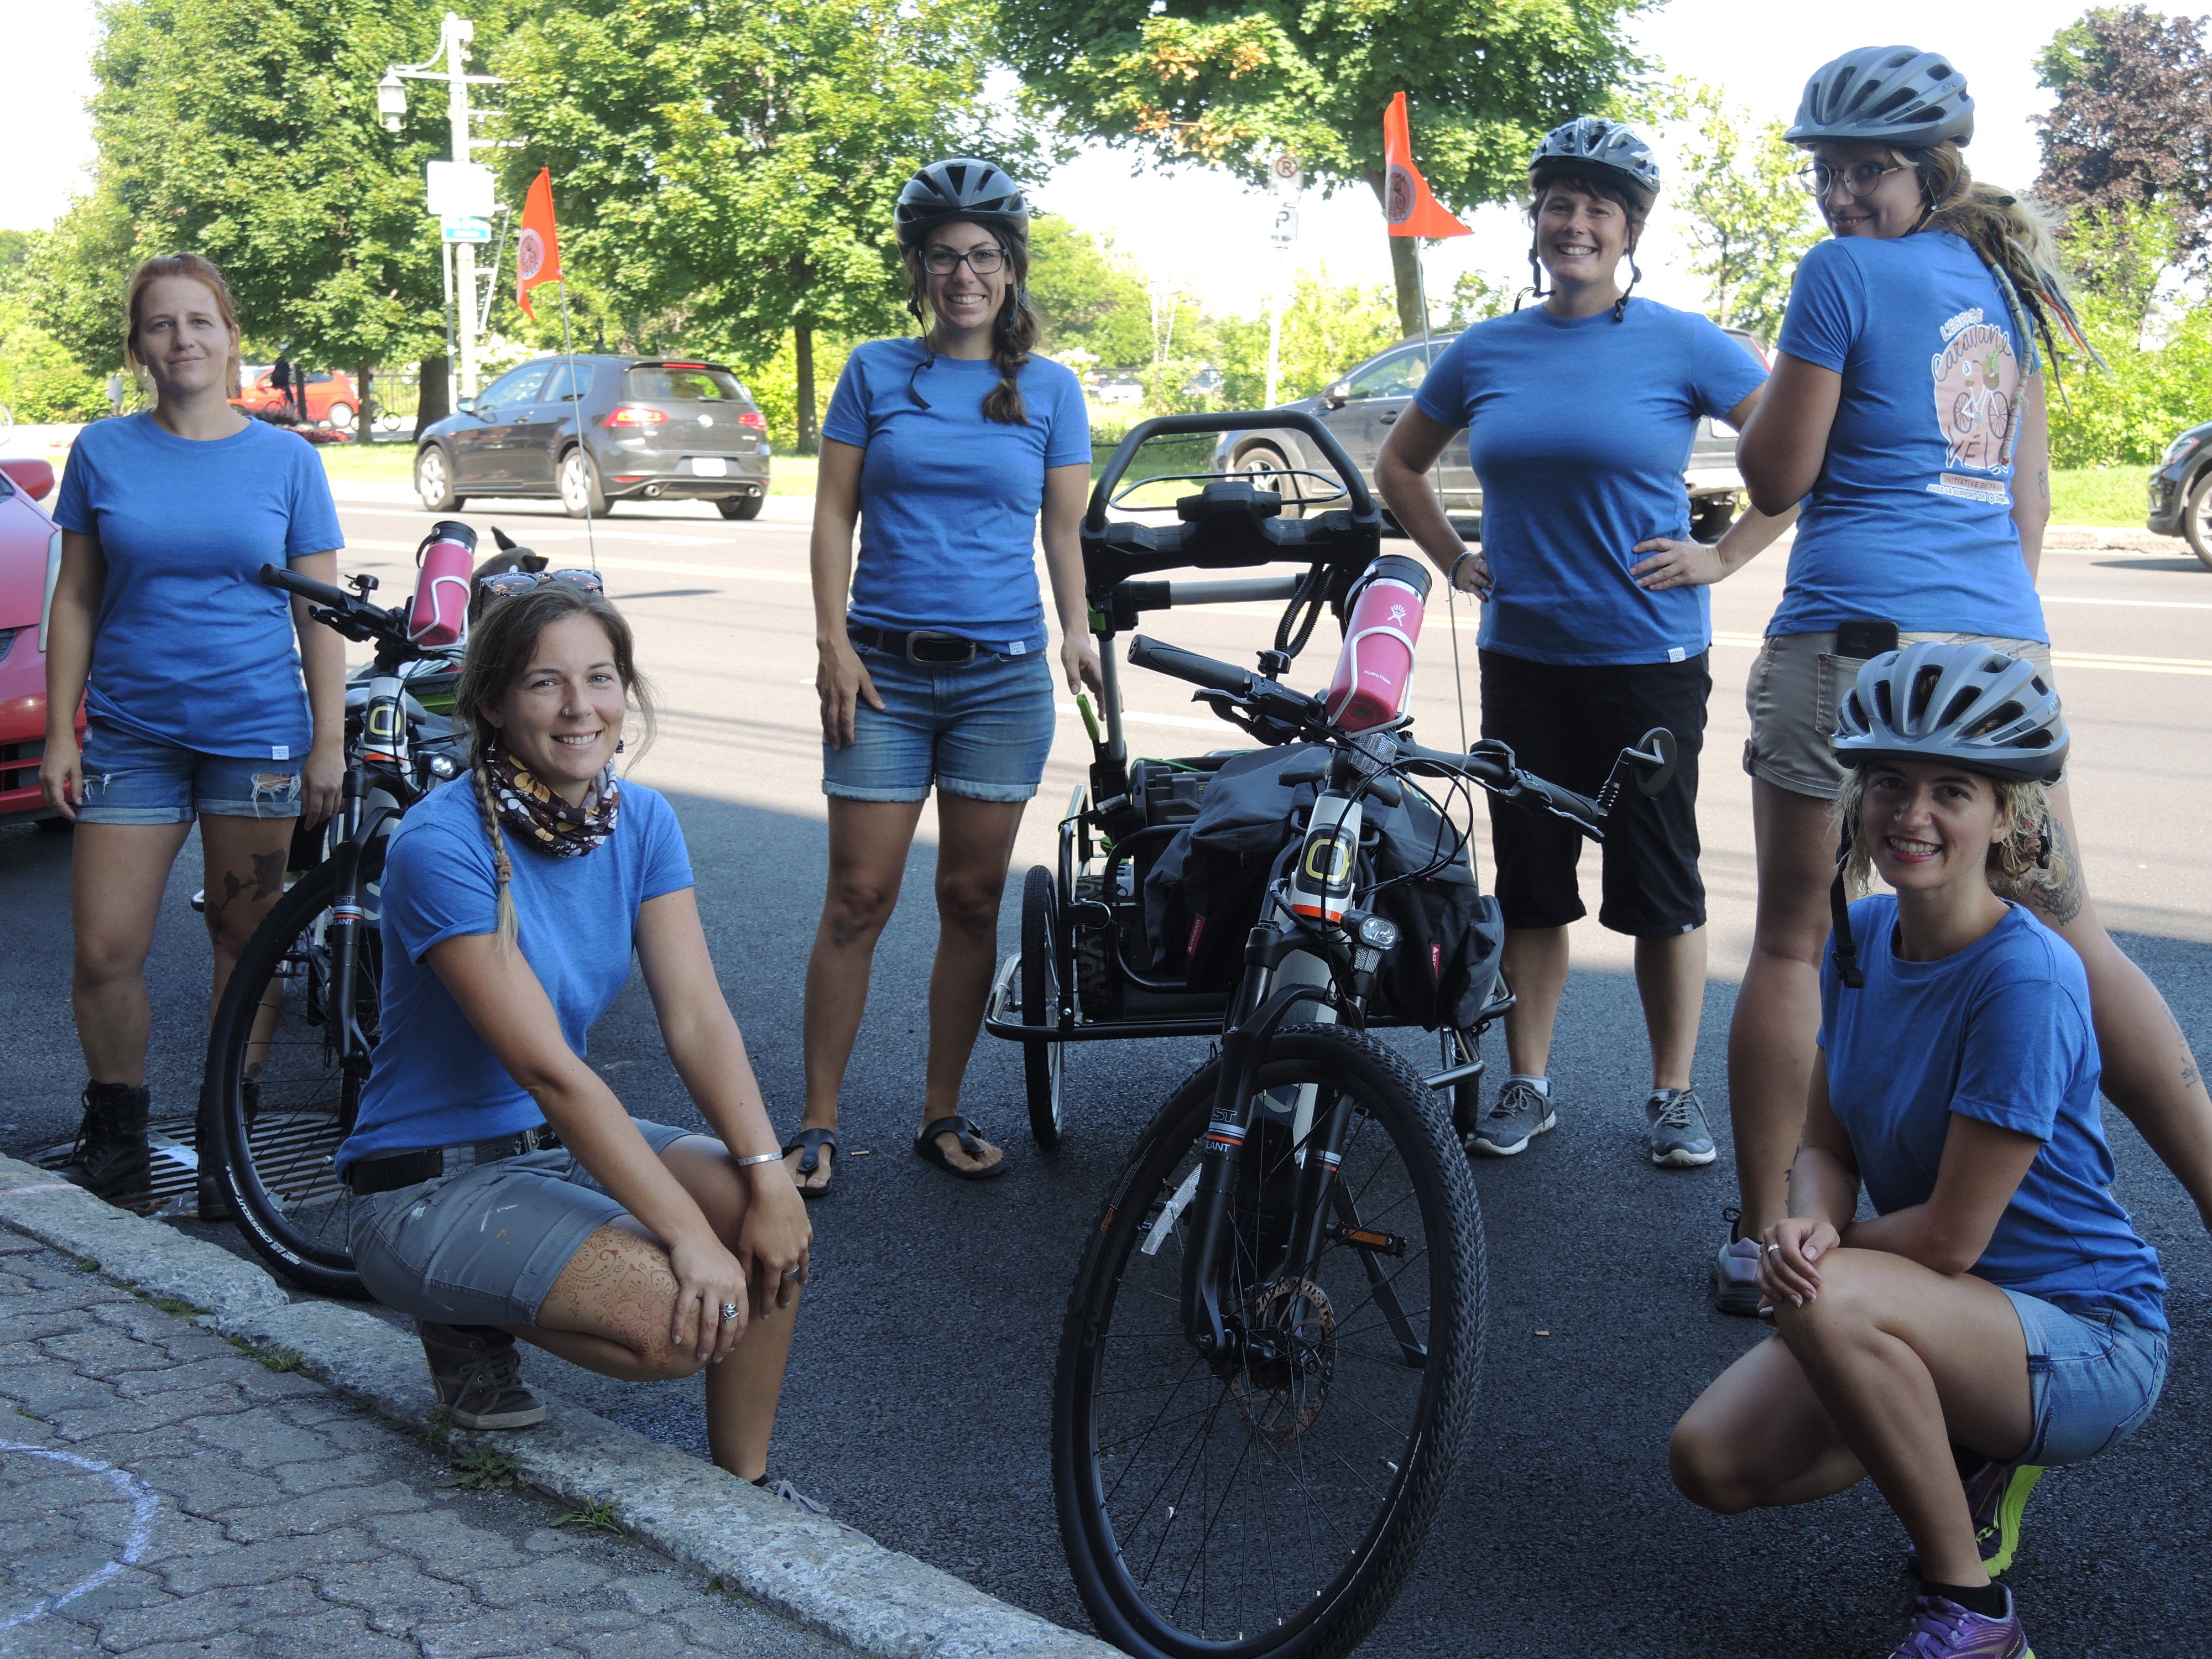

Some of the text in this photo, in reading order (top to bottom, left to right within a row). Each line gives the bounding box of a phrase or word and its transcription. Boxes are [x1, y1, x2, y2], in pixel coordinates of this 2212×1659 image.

[1940, 309, 1983, 341] L'ESPACE
[1933, 325, 2011, 382] Caravane
[1964, 363, 1970, 374] à
[1944, 476, 1979, 488] INITIATIVE
[1954, 489, 1977, 499] SUPPORT
[1364, 670, 1391, 686] Hydro Flask
